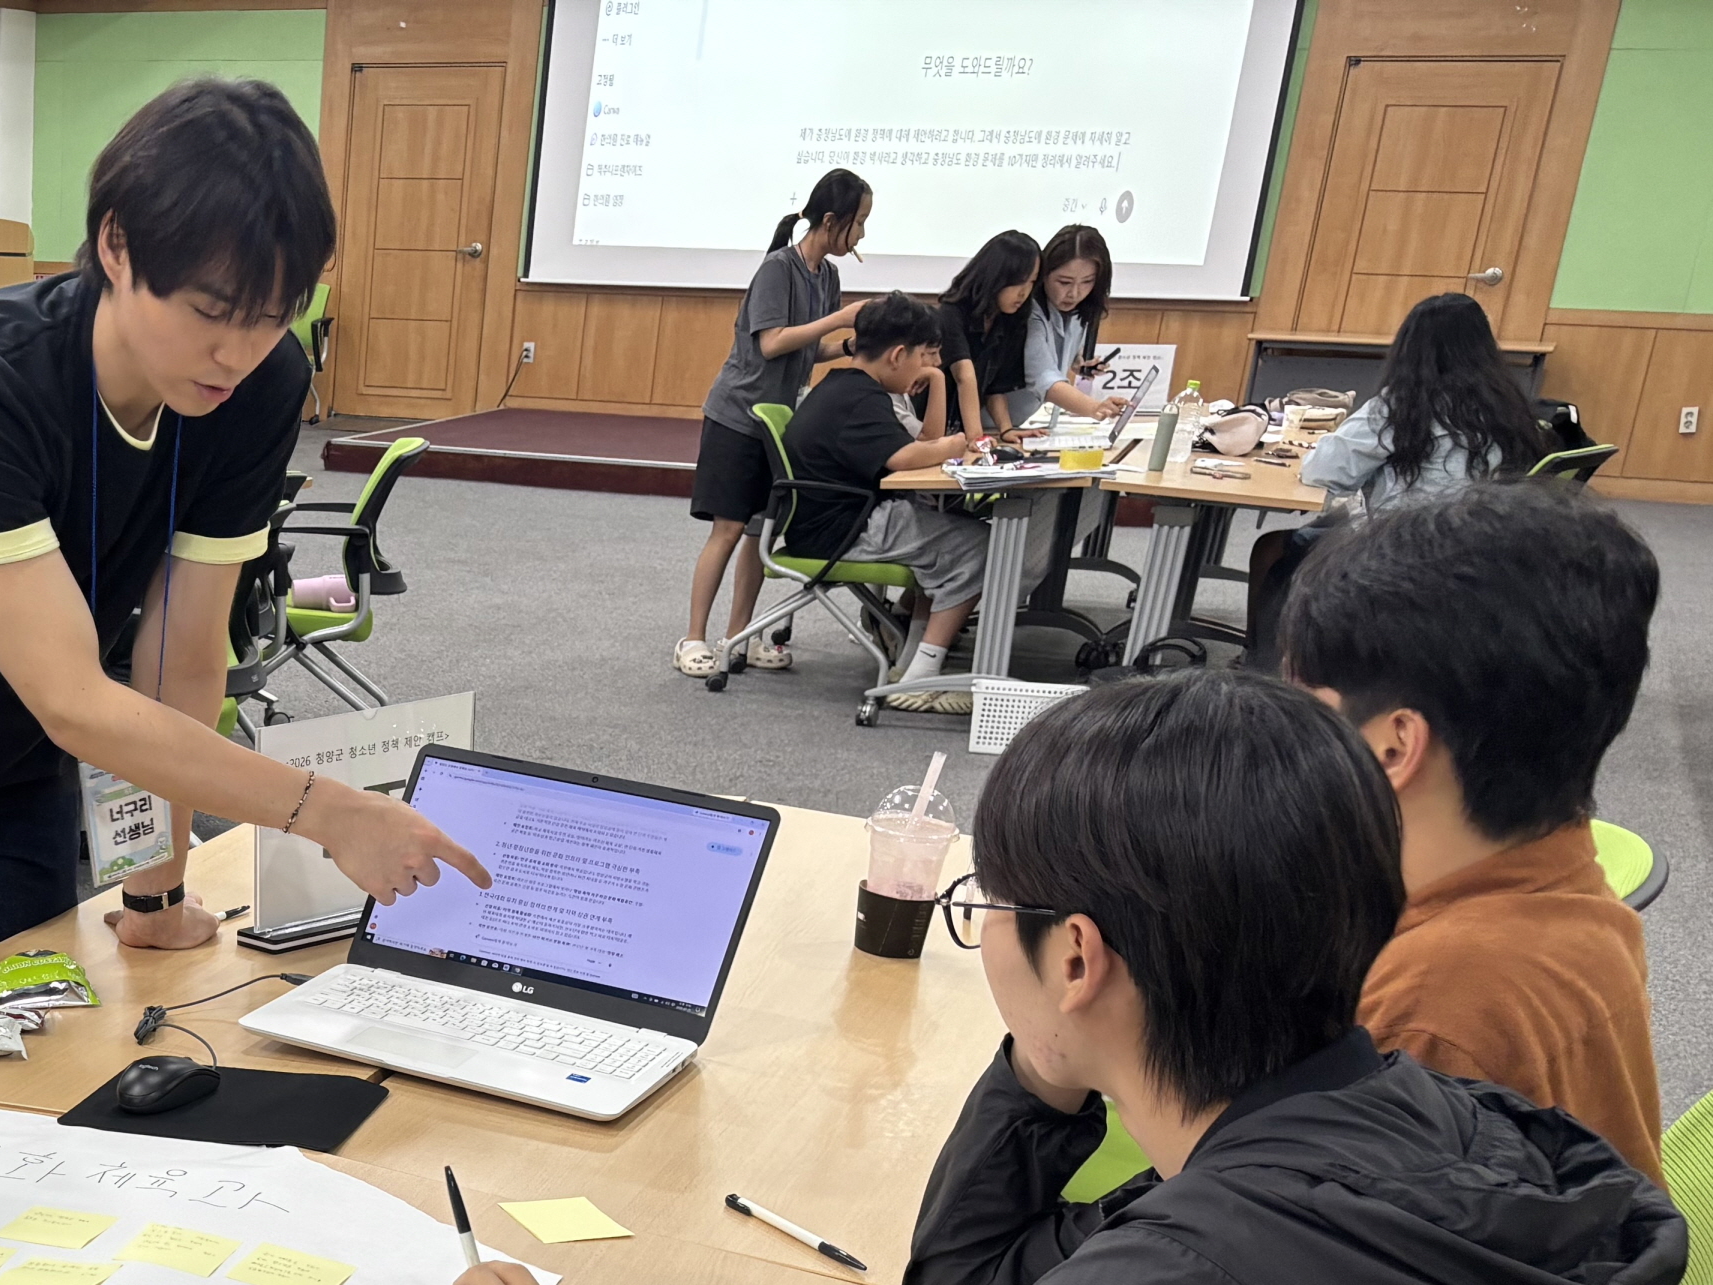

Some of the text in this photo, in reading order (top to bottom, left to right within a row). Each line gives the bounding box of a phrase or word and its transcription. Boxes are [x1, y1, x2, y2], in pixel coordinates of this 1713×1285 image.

[921, 55, 1034, 78] 무엇을 도와드릴까요?
[799, 127, 814, 141] 제가
[816, 128, 852, 142] 충청남도에
[854, 128, 869, 142] 환경
[871, 128, 893, 142] 정책에
[895, 128, 910, 143] 대해
[912, 128, 950, 143] 제안하려고
[978, 129, 1002, 144] 그래서
[1004, 129, 1042, 144] 충청남도에
[1044, 130, 1060, 145] 환경
[1062, 130, 1086, 145] 문제에
[1089, 130, 1112, 146] 자세히
[1115, 131, 1131, 146] 알고
[828, 151, 850, 165] 당신이
[852, 151, 867, 165] 환경
[900, 151, 930, 166] 생각하고
[932, 151, 962, 167] 충청남도
[964, 152, 980, 167] 환경
[982, 152, 1005, 167] 문제를
[1007, 153, 1039, 168] 10가지만
[1042, 153, 1072, 169] 정리해서
[1102, 368, 1143, 390] 2조
[316, 749, 343, 765] 청양군
[348, 743, 376, 759] 청소년
[381, 738, 399, 753] 정책
[404, 734, 422, 749] 제안
[109, 795, 153, 822] 너구리
[112, 817, 155, 846] 선생님
[522, 985, 534, 996] LG
